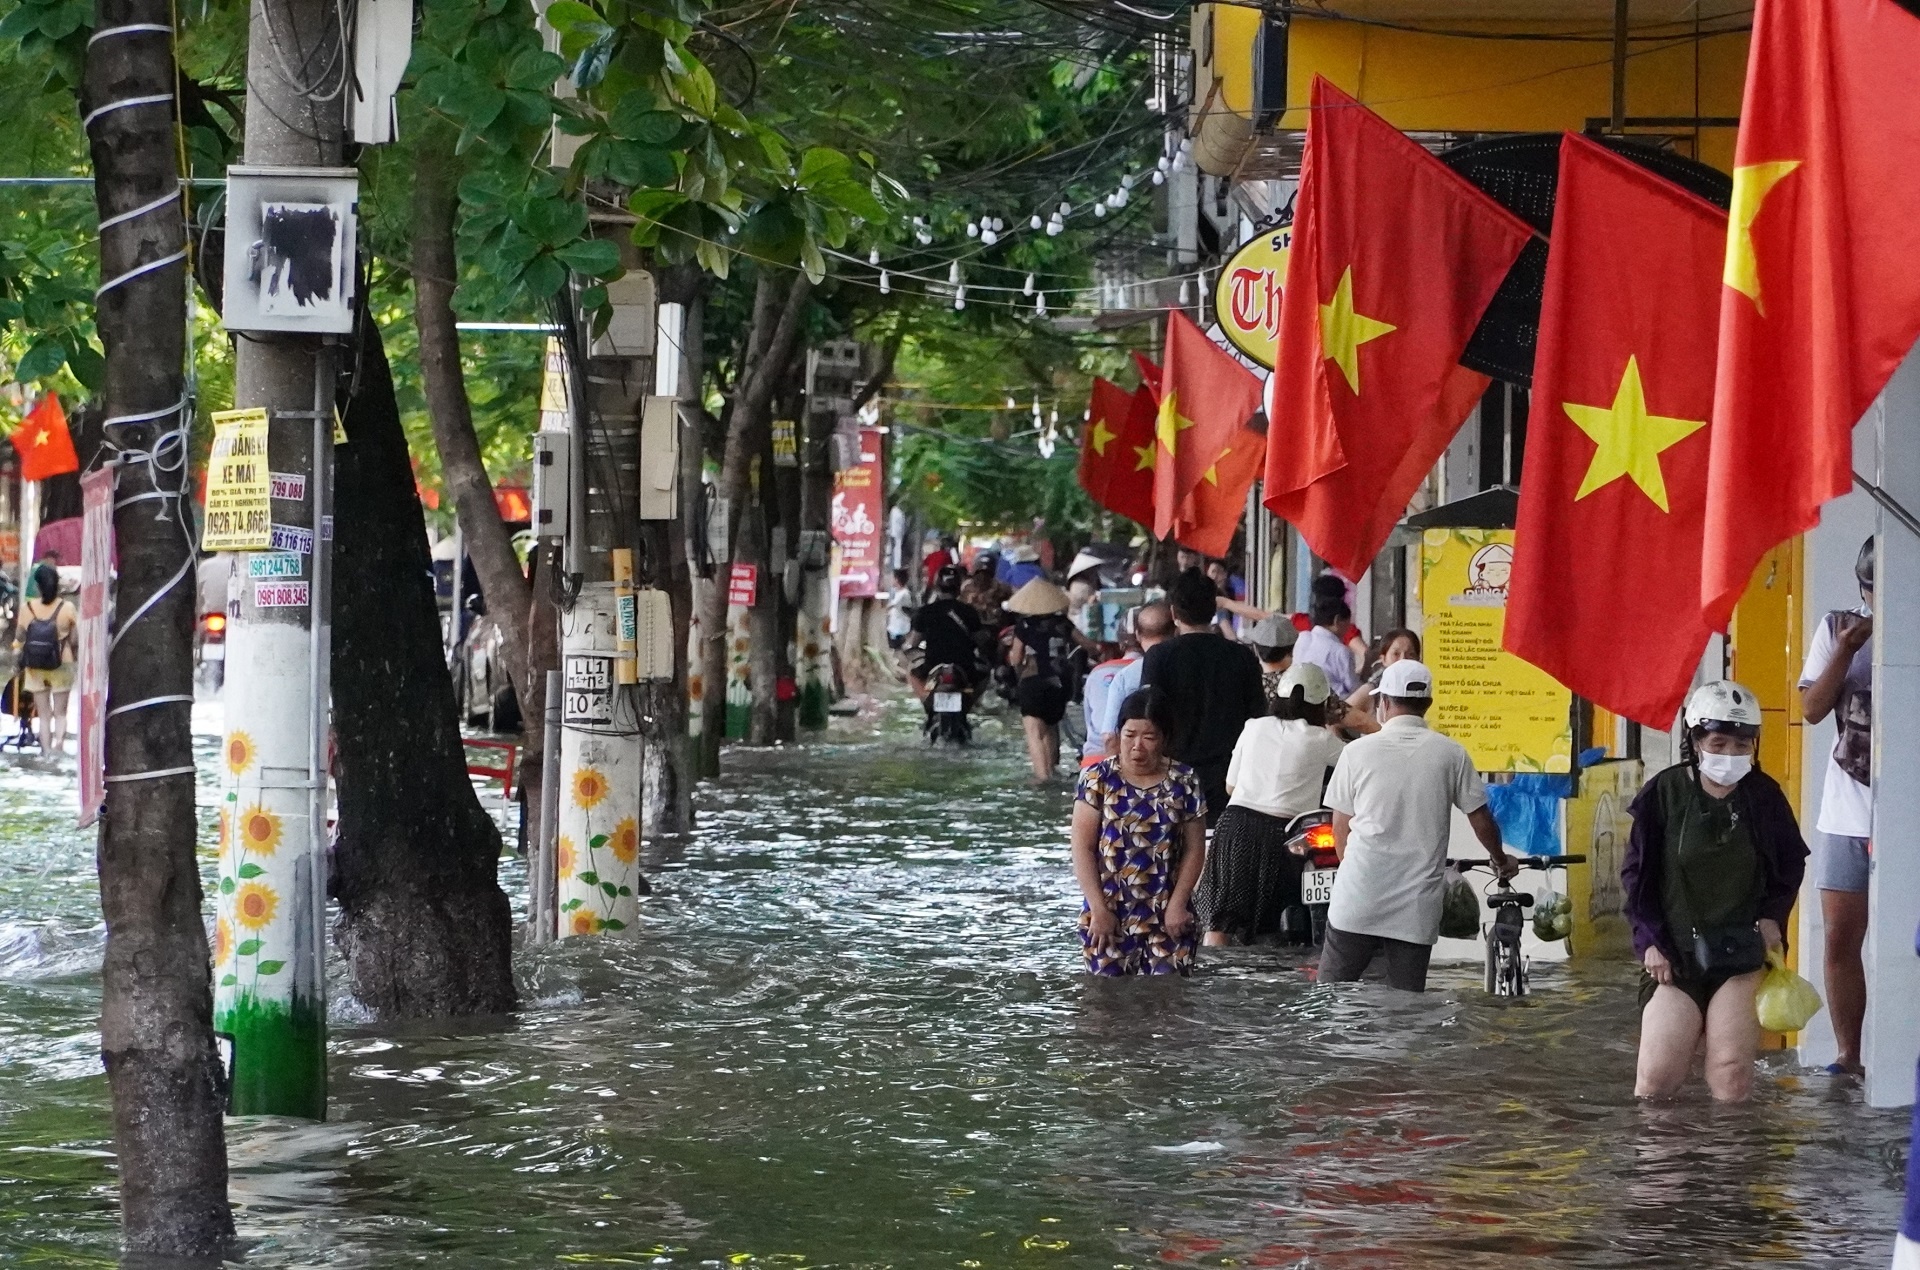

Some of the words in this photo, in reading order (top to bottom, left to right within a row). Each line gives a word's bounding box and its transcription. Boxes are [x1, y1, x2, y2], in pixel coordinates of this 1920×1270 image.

[222, 464, 233, 484] XE
[236, 460, 256, 483] MÁY
[1305, 886, 1331, 902] 805
